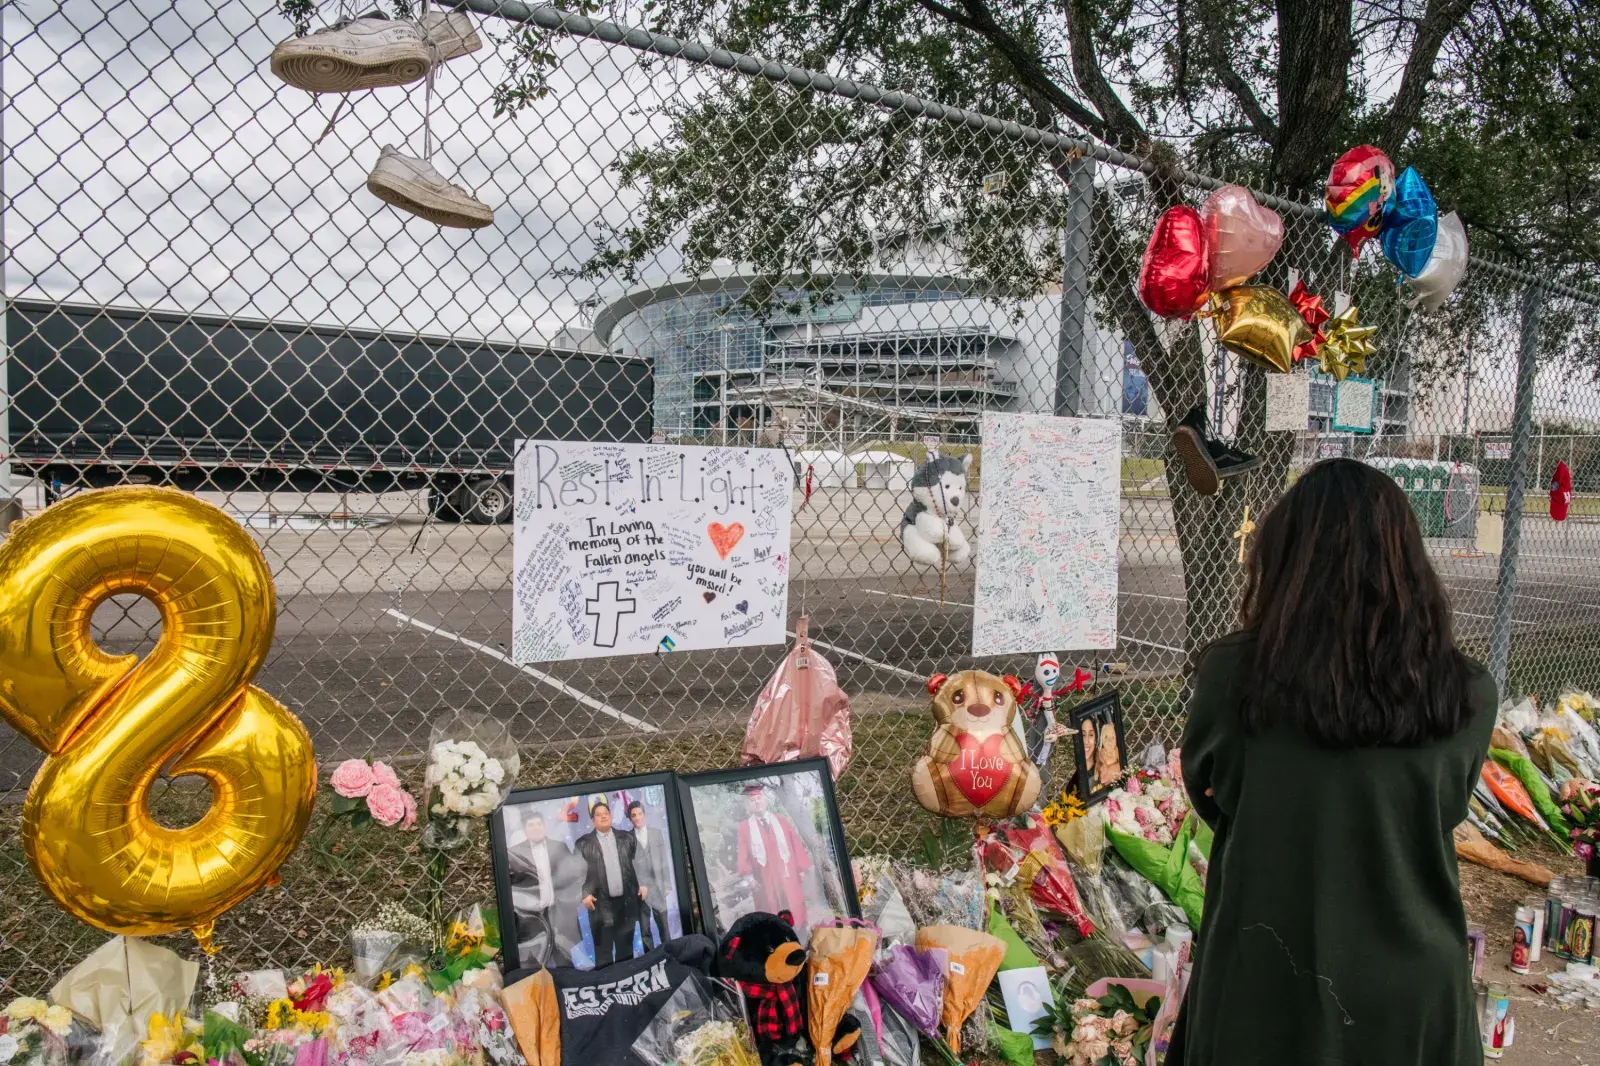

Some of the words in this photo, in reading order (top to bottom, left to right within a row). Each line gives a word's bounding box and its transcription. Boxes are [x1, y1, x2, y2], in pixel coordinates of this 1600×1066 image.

[536, 444, 624, 509] Rest
[638, 458, 663, 503] In
[679, 453, 764, 515] Light
[586, 517, 606, 538] In
[610, 520, 656, 538] Loving
[569, 536, 621, 552] memory
[626, 534, 641, 546] of
[644, 534, 664, 546] the
[585, 553, 621, 568] Fallen
[624, 549, 666, 566] angels
[686, 563, 706, 580] you
[708, 567, 728, 580] will
[730, 572, 742, 586] be
[960, 748, 967, 770] I
[970, 749, 1004, 771] Love
[970, 770, 993, 790] You
[561, 959, 672, 1011] ESTERN
